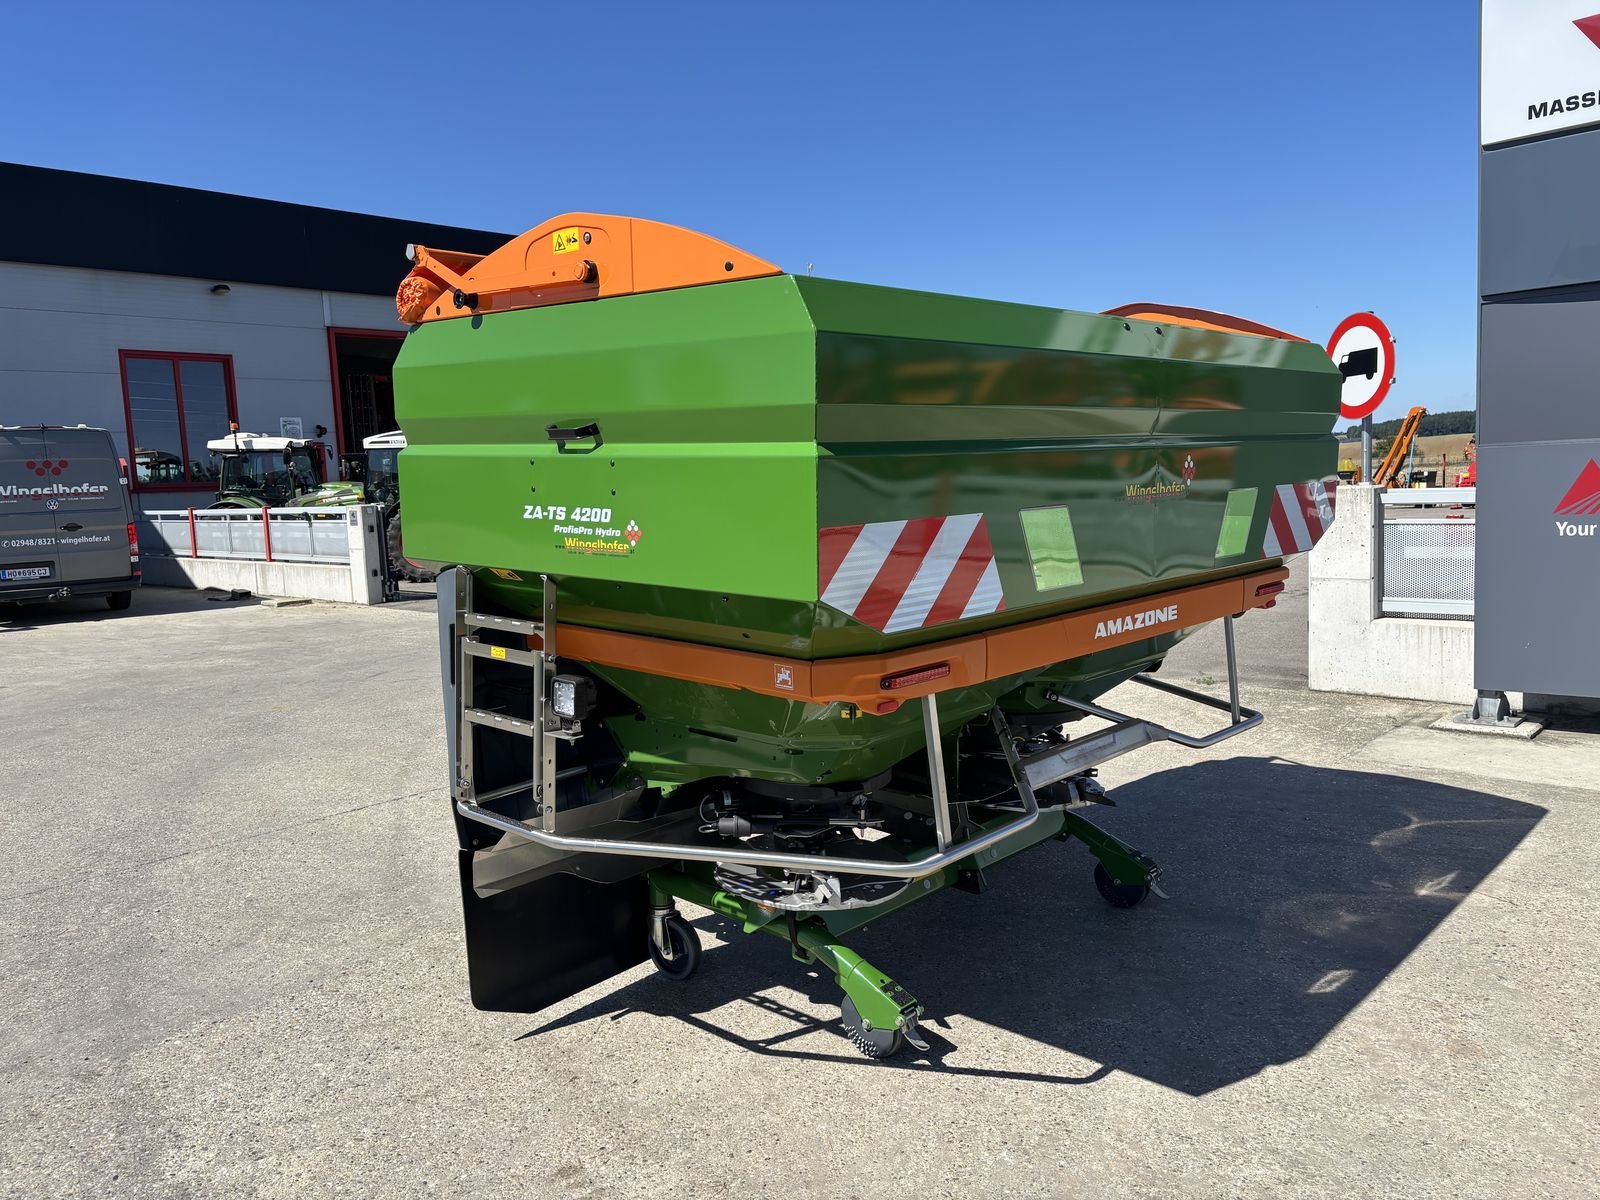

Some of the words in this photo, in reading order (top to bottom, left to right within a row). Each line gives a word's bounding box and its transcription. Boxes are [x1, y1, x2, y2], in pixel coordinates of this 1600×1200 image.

[1528, 90, 1600, 120] MASS
[1126, 482, 1185, 502] Wingelhofer
[523, 505, 567, 520] ZA-TS
[570, 507, 612, 522] 4200
[553, 525, 593, 535] ProfisPro
[595, 527, 621, 538] Hydro
[1555, 521, 1598, 537] Your
[11, 538, 55, 547] 02948/8321
[61, 535, 110, 545] wingelhofer.at
[565, 537, 629, 554] Wingelhofer
[1094, 604, 1178, 640] AMAZONE
